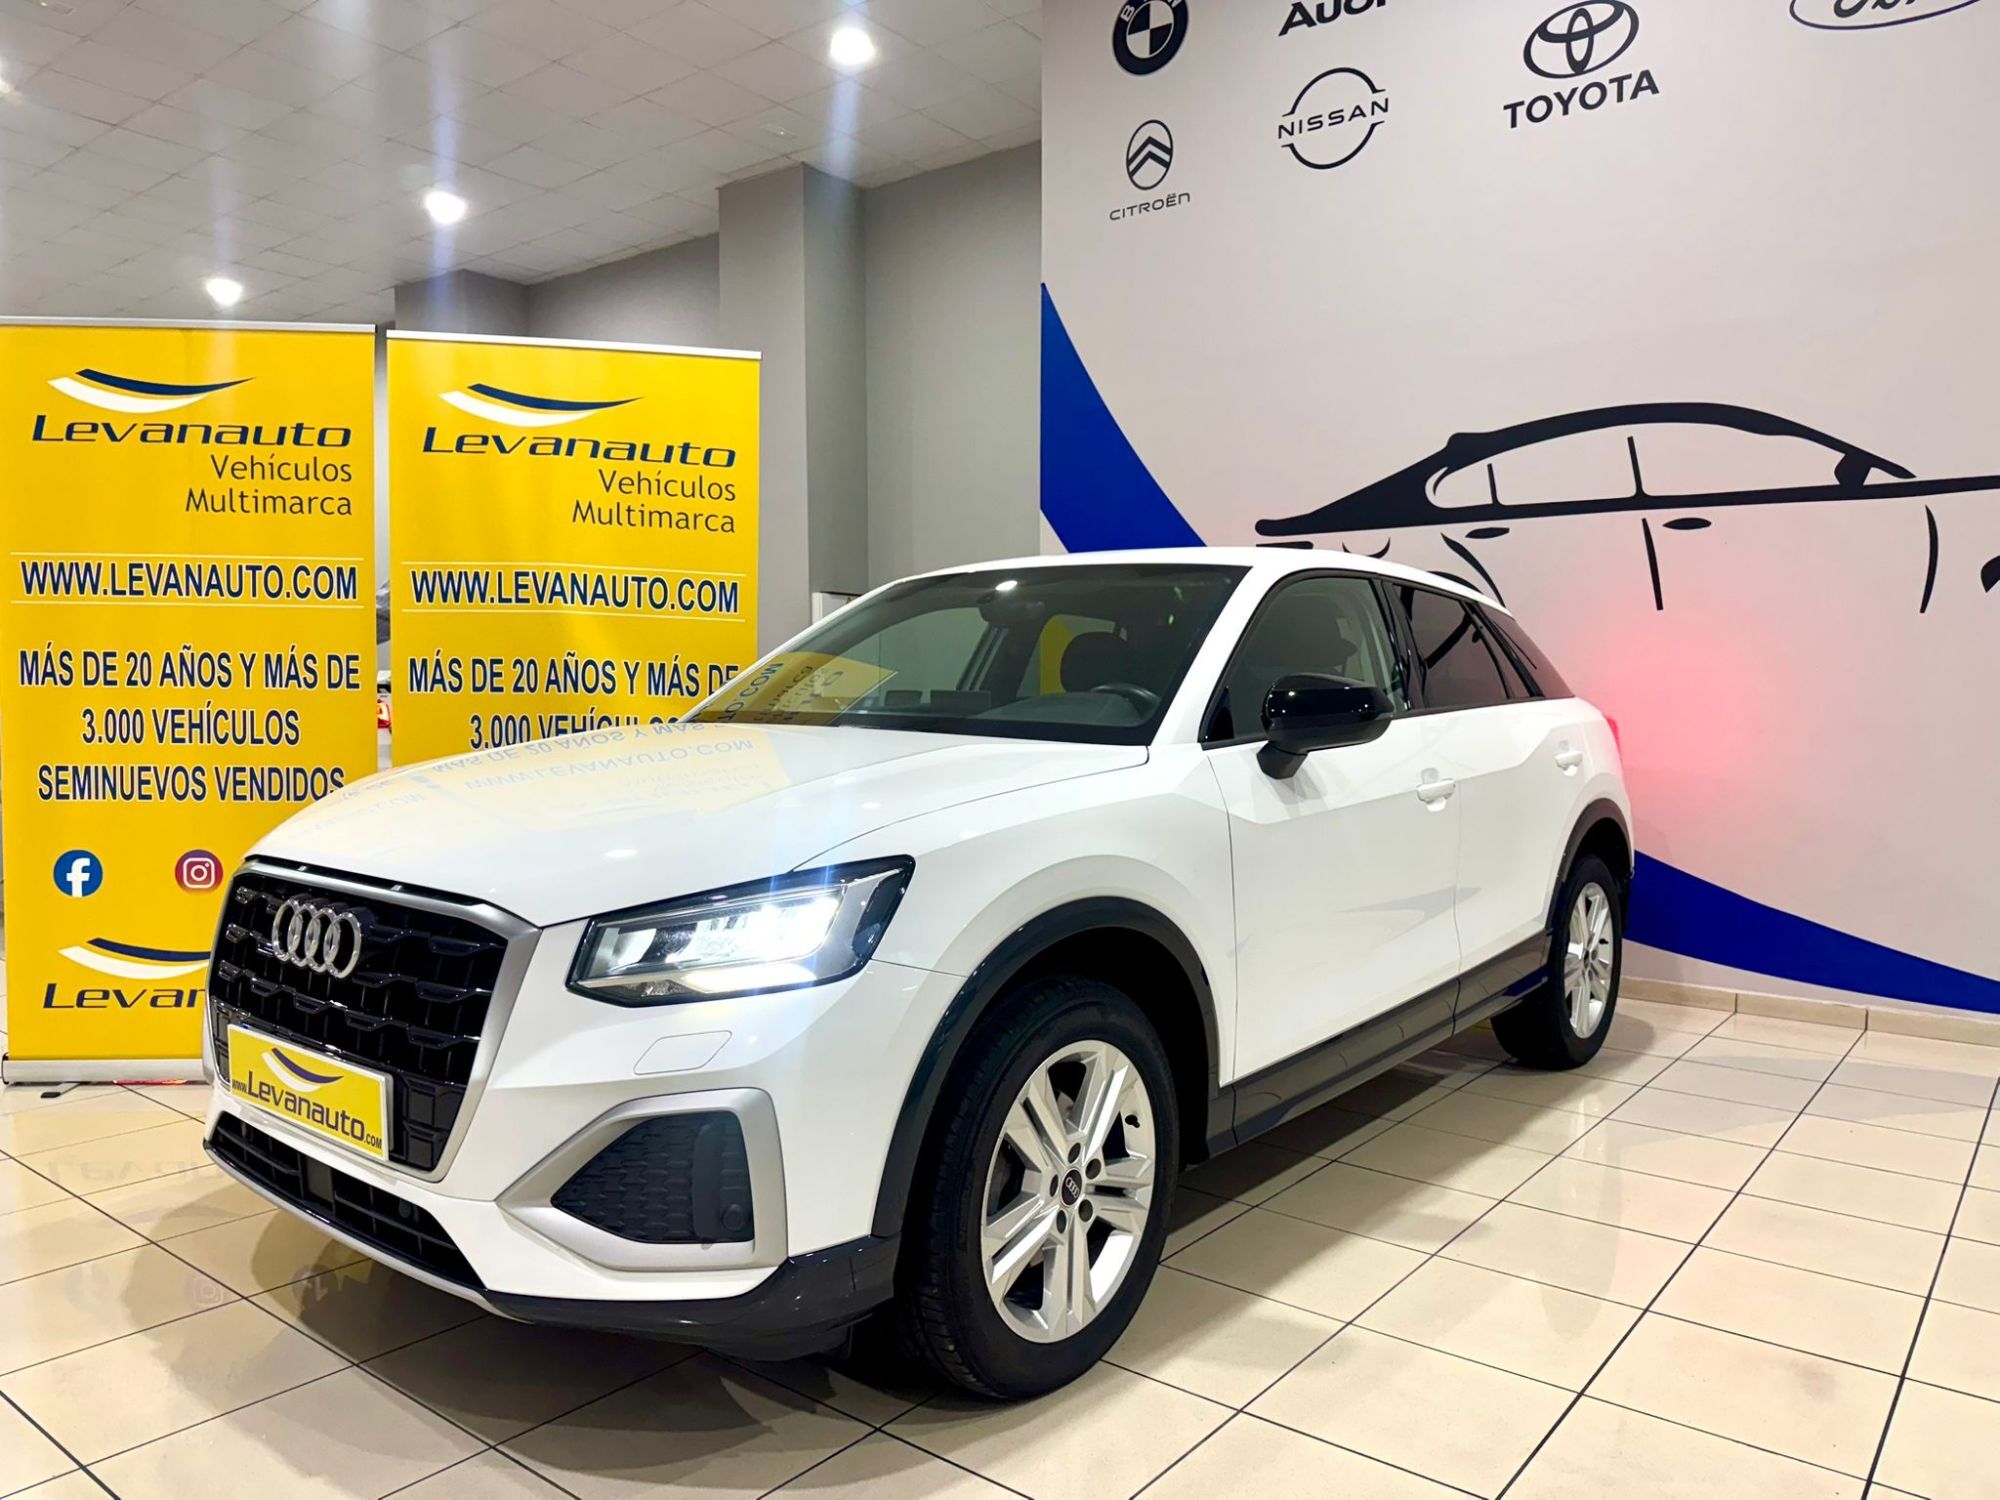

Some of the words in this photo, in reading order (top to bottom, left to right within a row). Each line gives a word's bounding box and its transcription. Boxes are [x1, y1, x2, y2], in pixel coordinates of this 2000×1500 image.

[1278, 97, 1389, 140] NISSAN
[1503, 69, 1660, 129] TOYOTA
[32, 415, 352, 447] Levanauto
[422, 427, 736, 468] Levanauto
[211, 454, 352, 482] Vehículos
[598, 468, 736, 501] Vehículos
[186, 488, 352, 515] Multimarca
[572, 500, 735, 533] Multimarca
[21, 561, 357, 600] WWW.LEVANAUTO.COM
[411, 570, 738, 613] WWW.LEVANAUTO.COM
[20, 642, 73, 686] MÁS
[83, 651, 118, 686] DE
[126, 651, 152, 687] 20
[159, 644, 232, 688] AÑOS
[239, 653, 257, 688] Y
[264, 645, 318, 689] MÁS
[327, 654, 360, 689] DE
[409, 649, 463, 693] MÁS
[471, 658, 504, 693] DE
[512, 658, 538, 693] 20
[545, 651, 616, 695] AÑOS
[623, 661, 640, 695] Y
[647, 654, 700, 697] MÁS
[82, 708, 144, 744] 3.000
[151, 700, 300, 746] VEHÍCULOS
[470, 714, 531, 750] 3.000
[38, 764, 207, 801] SEMINUEVOS
[214, 766, 345, 802] VENDIDOS
